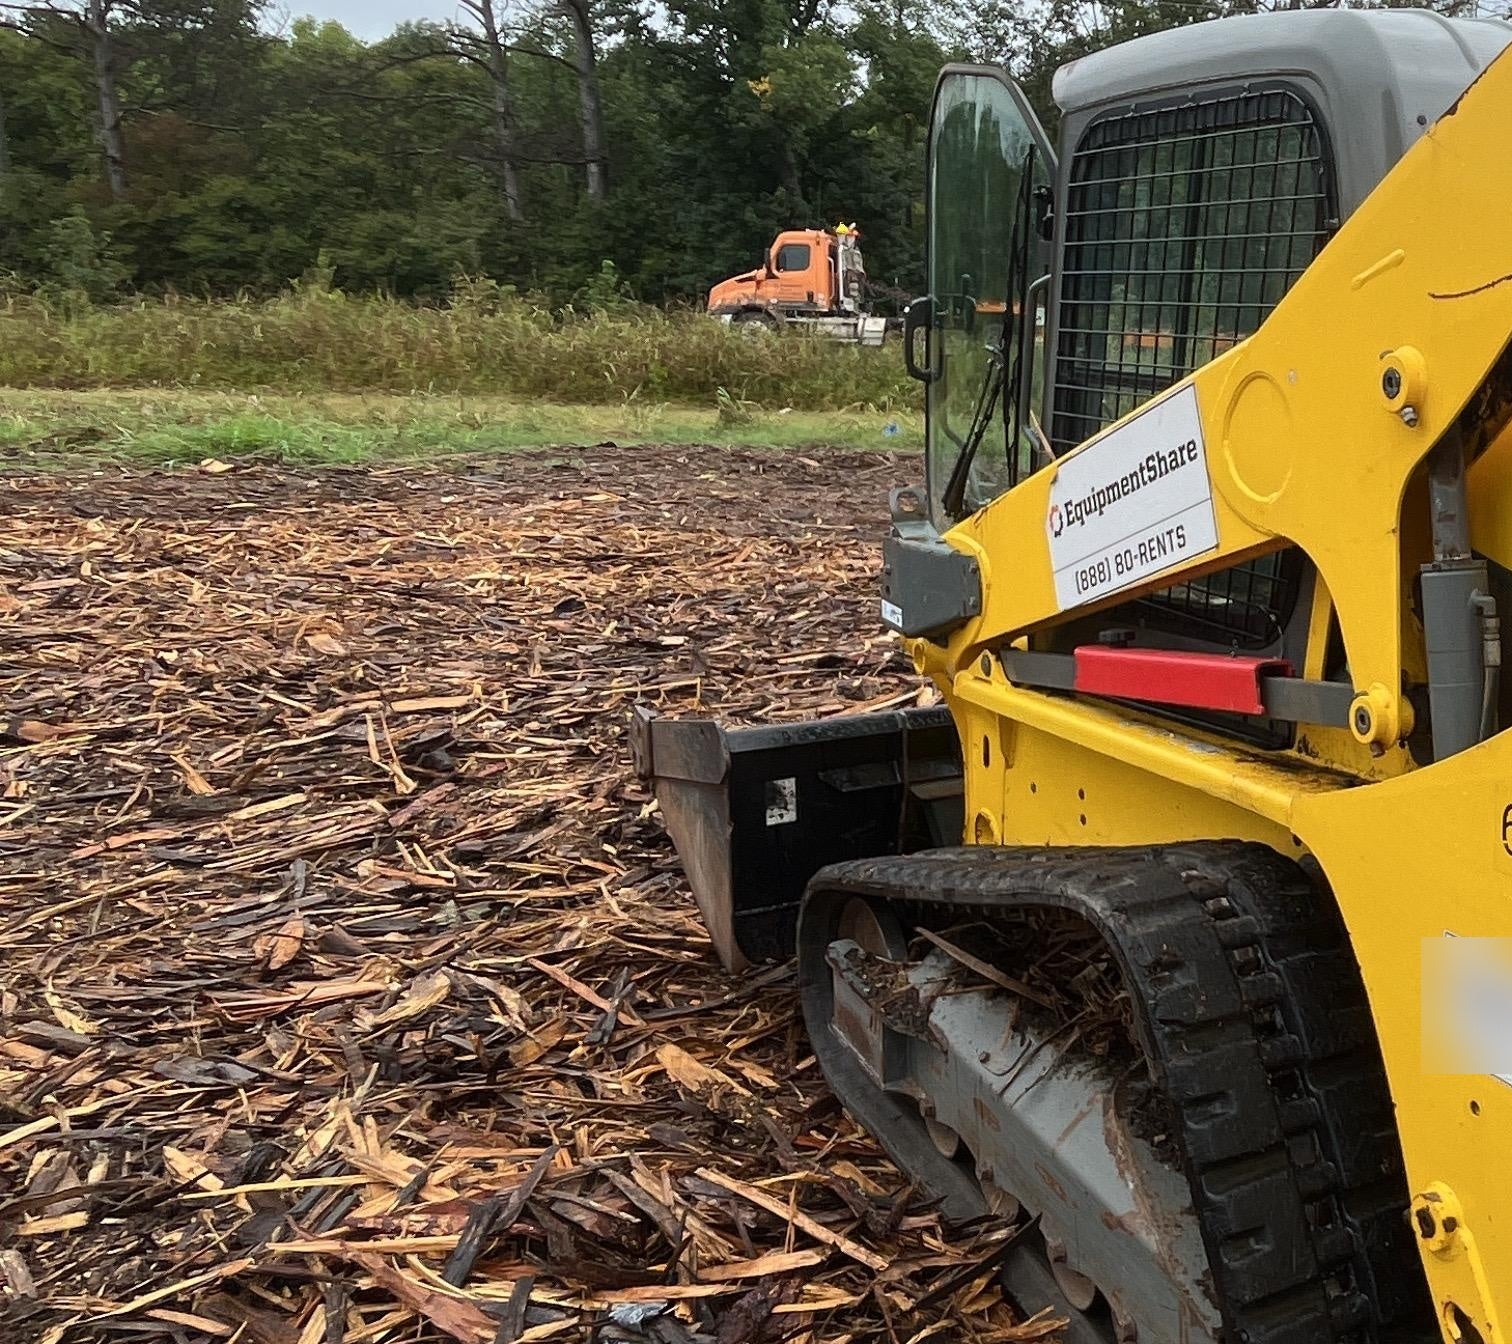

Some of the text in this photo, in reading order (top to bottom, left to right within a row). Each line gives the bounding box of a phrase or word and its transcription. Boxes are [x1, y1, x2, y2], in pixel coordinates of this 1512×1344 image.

[1064, 439, 1198, 527] EquipmentShare
[1075, 524, 1187, 594] (888) 80-RENTS
